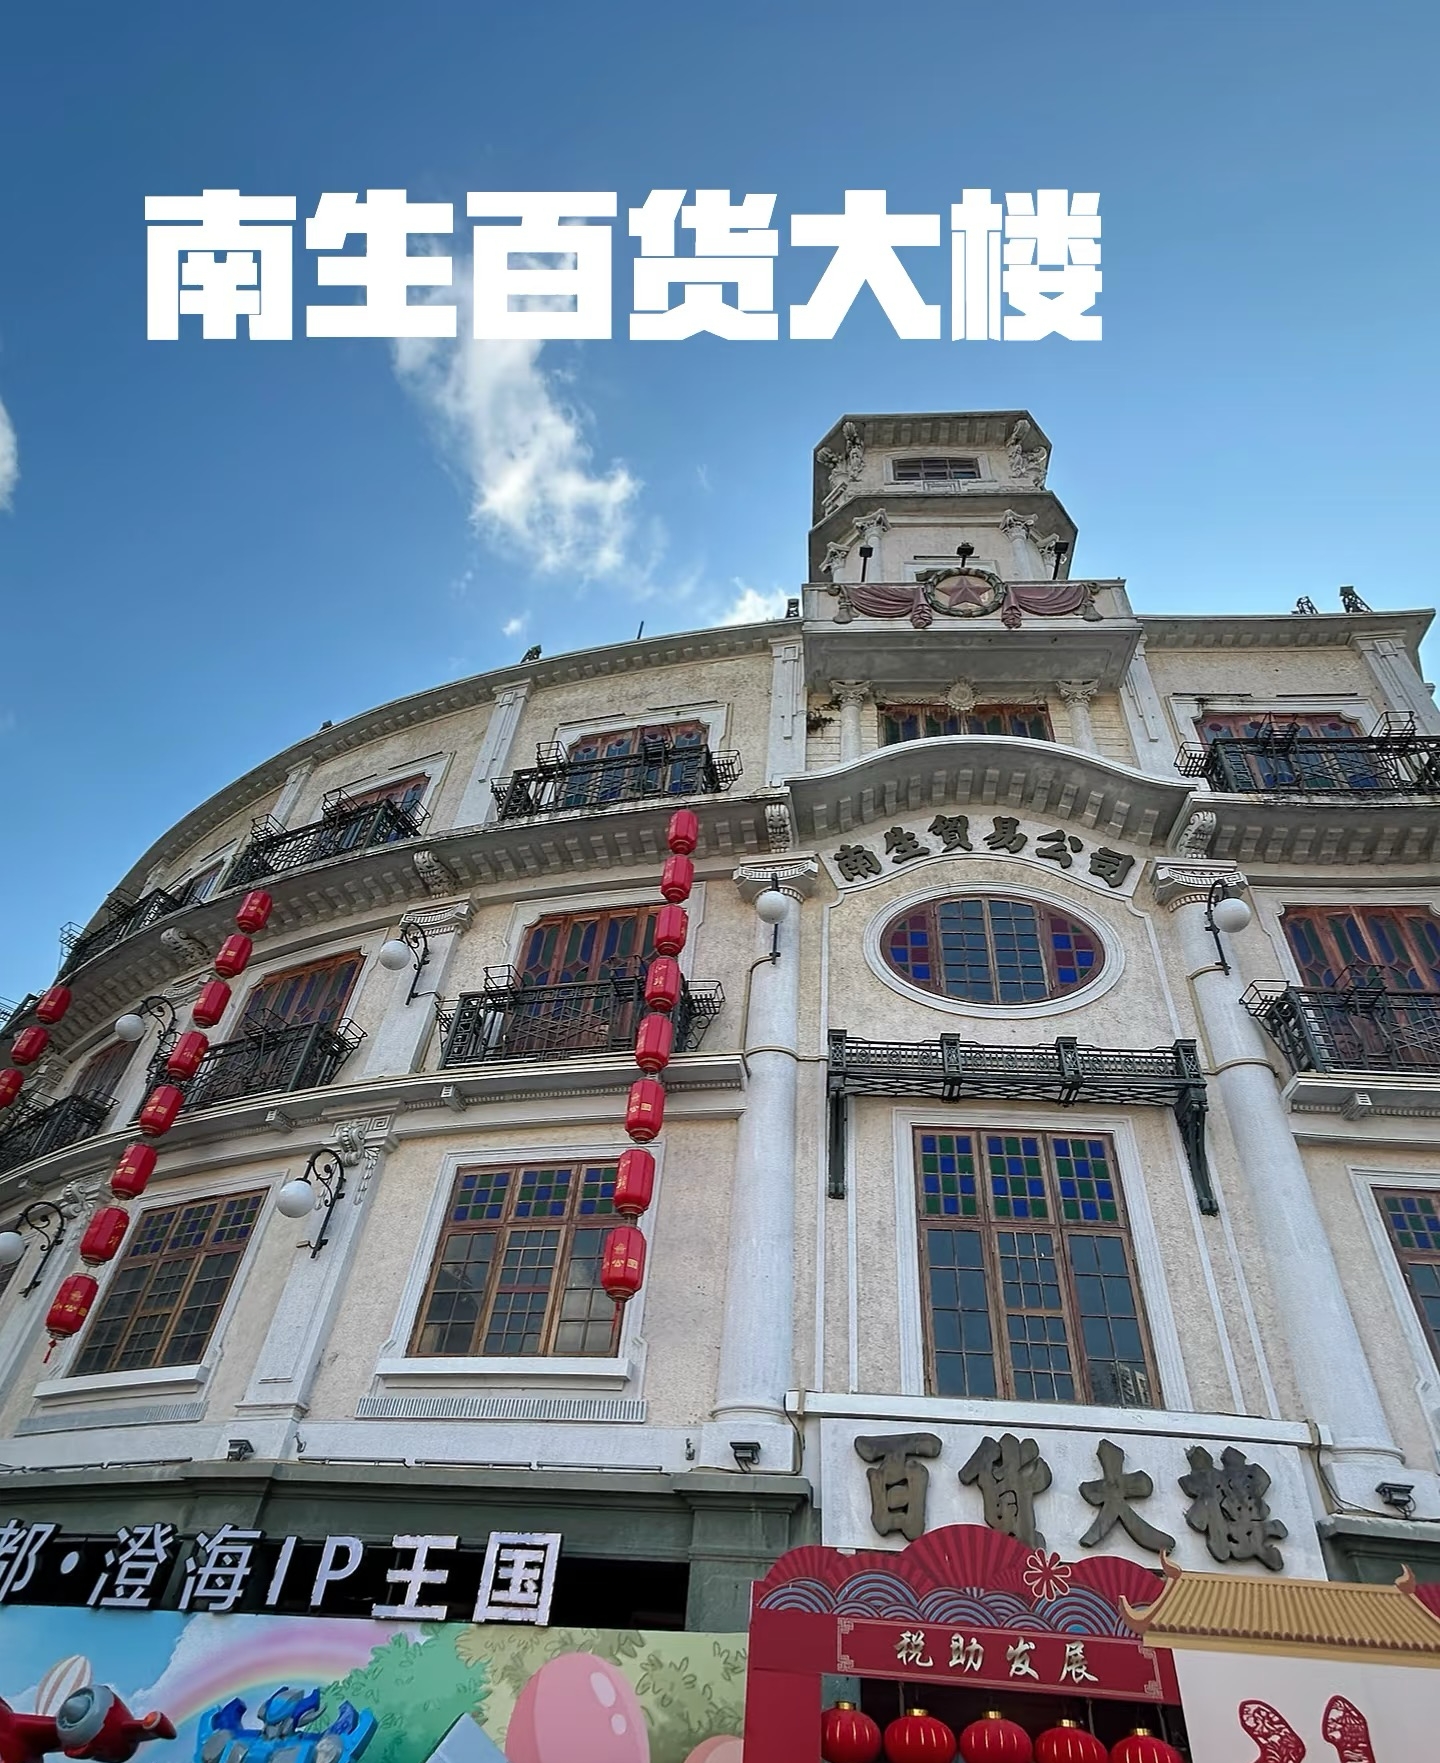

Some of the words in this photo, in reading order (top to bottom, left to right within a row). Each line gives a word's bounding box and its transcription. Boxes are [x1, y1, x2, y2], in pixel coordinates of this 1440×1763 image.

[833, 814, 1136, 889] 南生貿易公司
[854, 1432, 1288, 1572] 百貨大樓
[894, 1629, 1099, 1684] 税助发展
